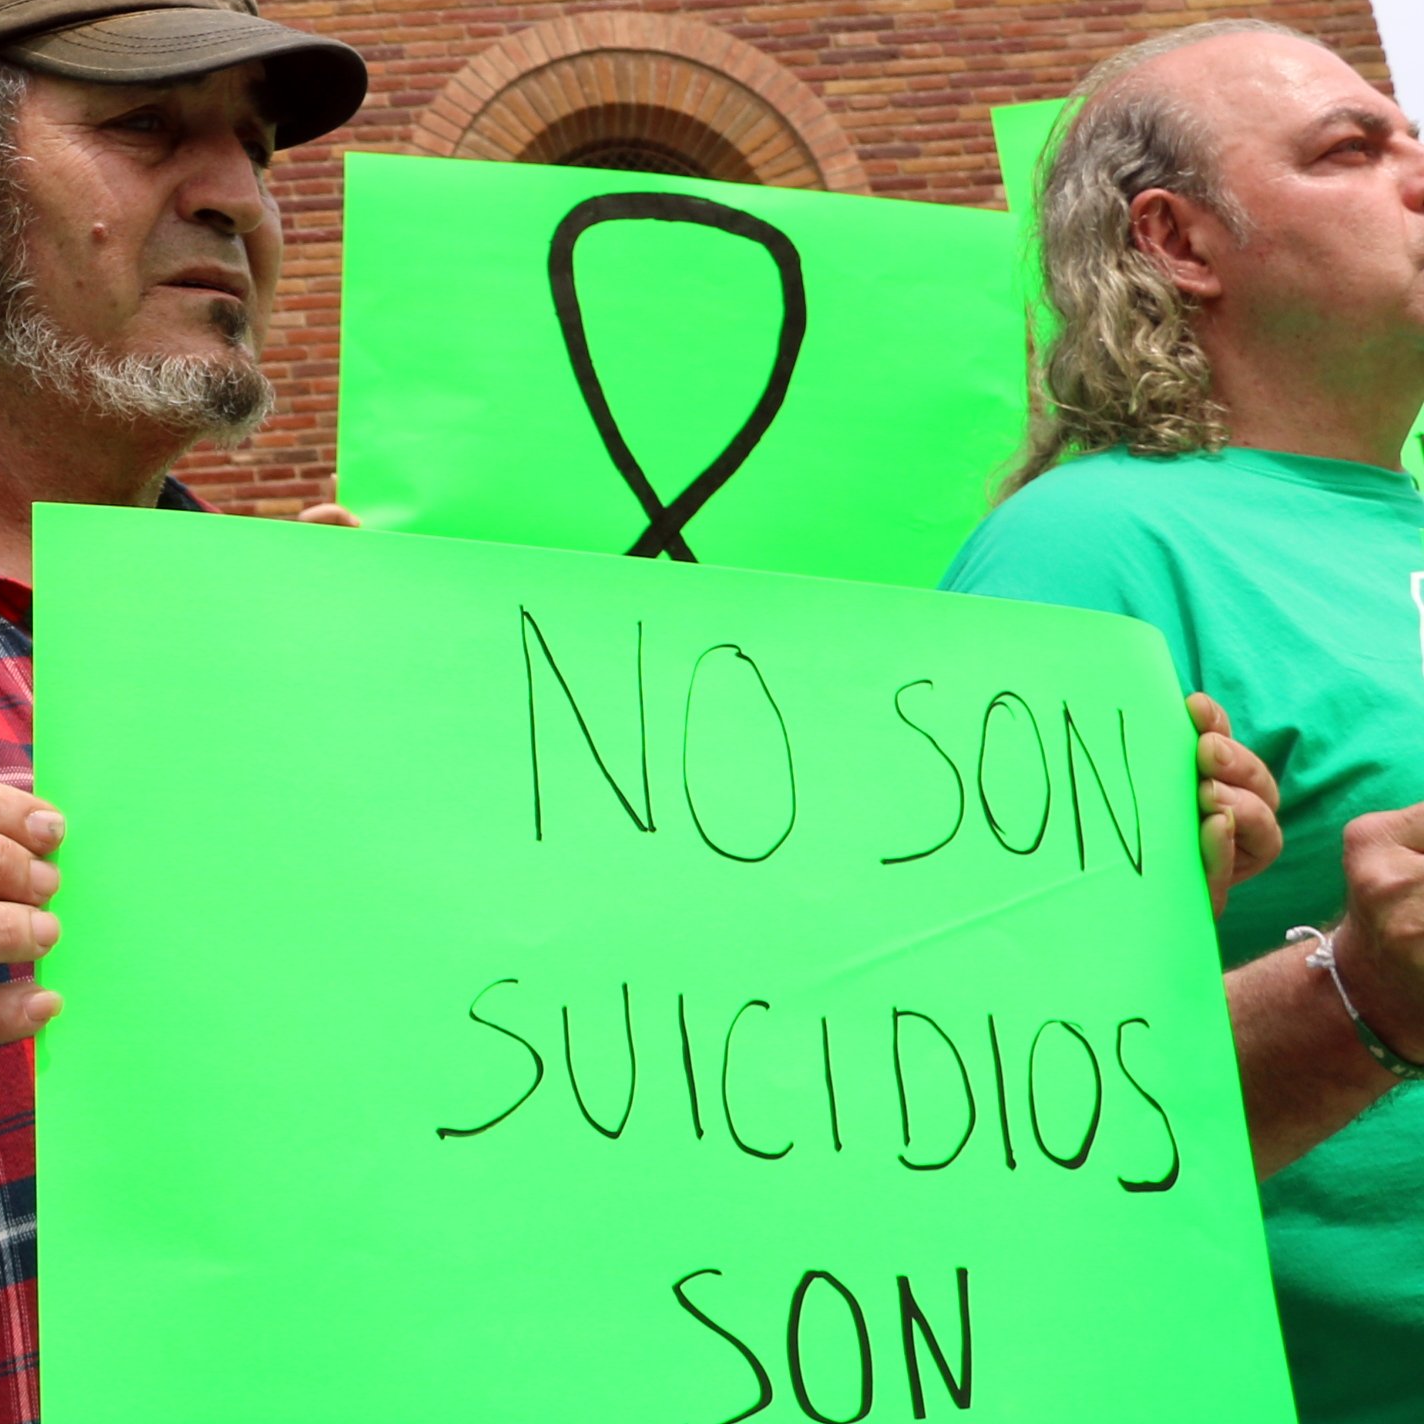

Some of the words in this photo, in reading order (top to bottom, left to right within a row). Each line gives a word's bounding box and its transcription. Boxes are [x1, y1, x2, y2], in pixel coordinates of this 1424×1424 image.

[520, 605, 796, 863] NO
[881, 679, 1143, 876] SON
[436, 978, 1180, 1193] SUICIDIOS
[672, 1268, 973, 1424] SON
